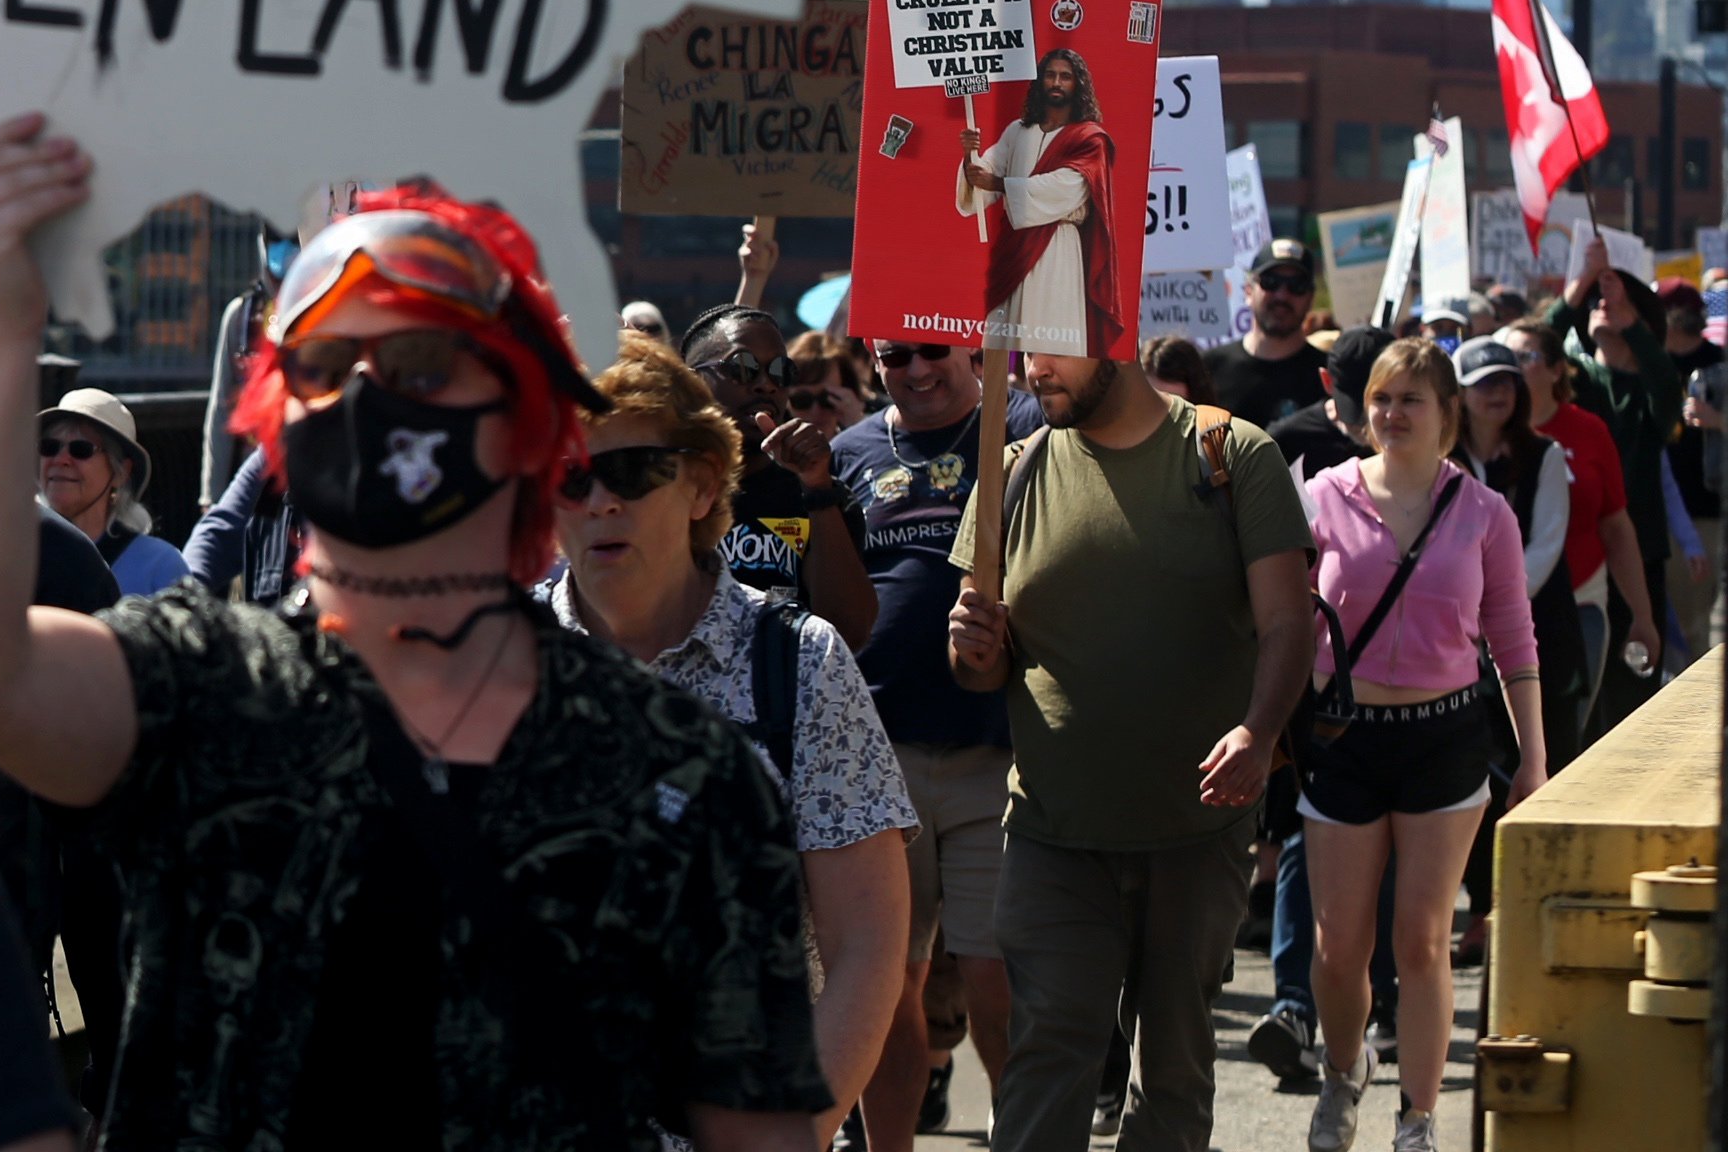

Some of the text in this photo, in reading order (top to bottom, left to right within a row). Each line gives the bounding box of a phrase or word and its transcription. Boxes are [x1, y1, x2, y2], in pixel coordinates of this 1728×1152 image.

[927, 9, 997, 31] NOT A
[686, 24, 860, 74] CHINGA
[904, 30, 1024, 56] CHRISTIAN
[928, 54, 1005, 78] VALUE
[744, 72, 793, 100] LA
[947, 75, 987, 88] NO KINGS
[948, 84, 988, 96] LIVE HERE
[1151, 305, 1190, 324] WITH
[1198, 308, 1220, 326] US
[902, 312, 1082, 345] notmyczar.com
